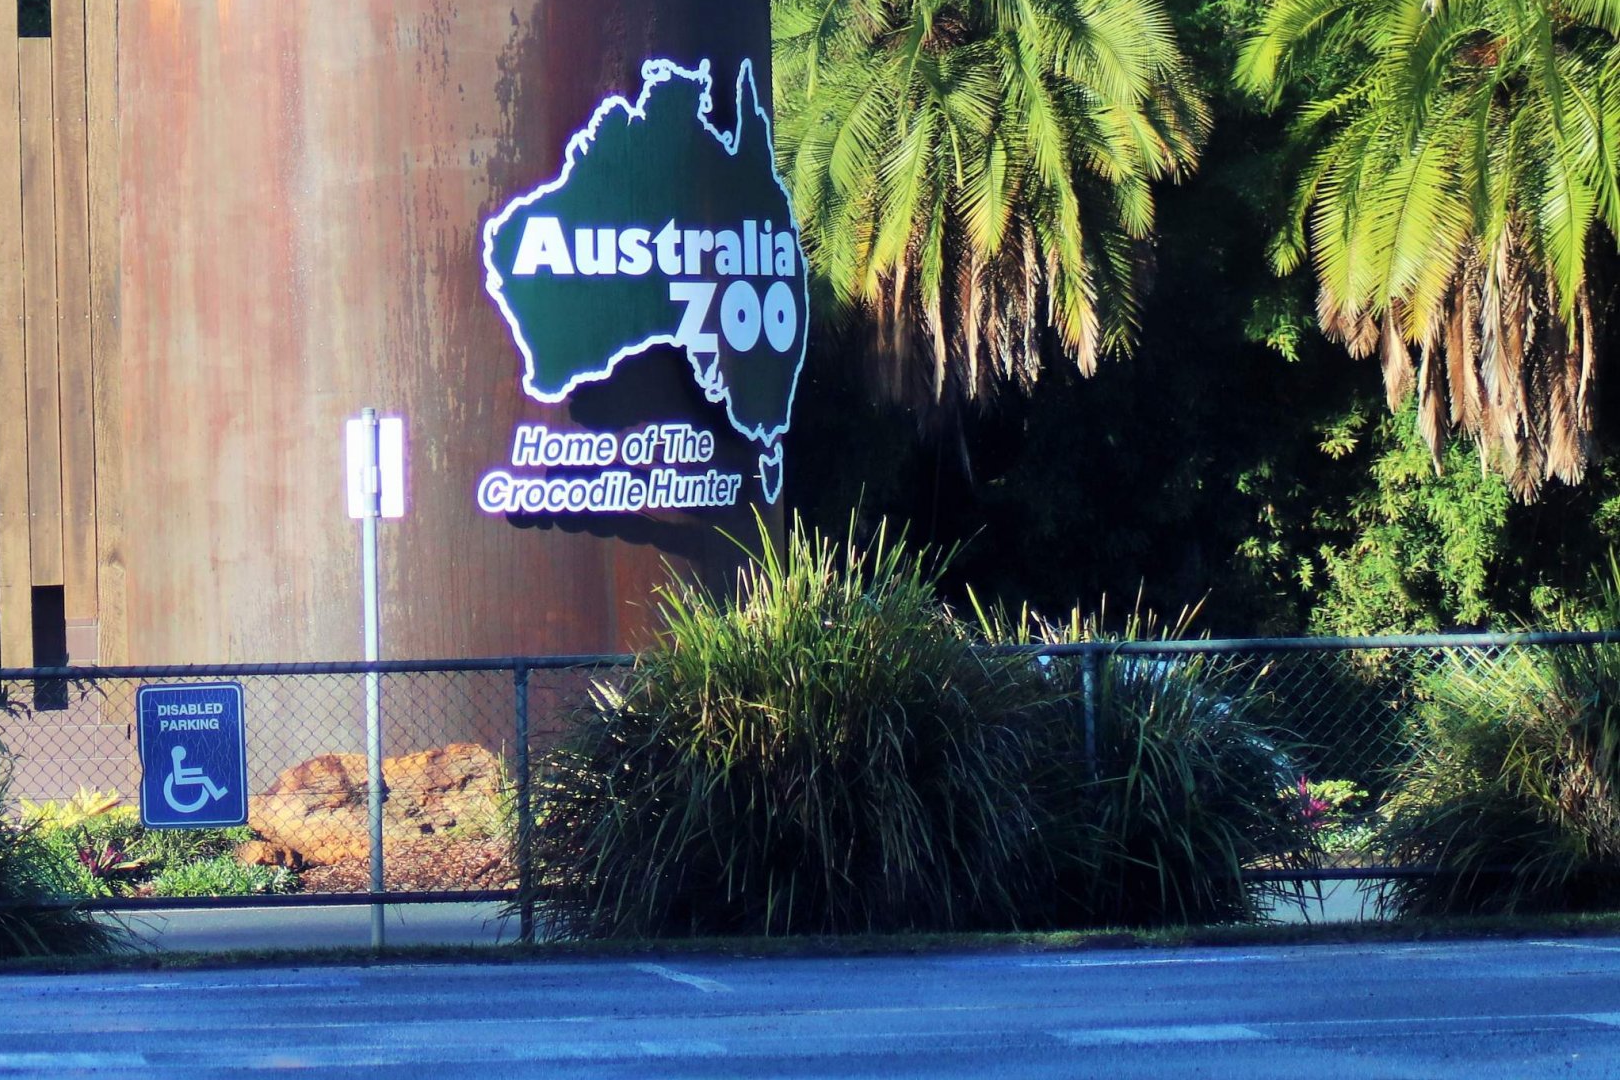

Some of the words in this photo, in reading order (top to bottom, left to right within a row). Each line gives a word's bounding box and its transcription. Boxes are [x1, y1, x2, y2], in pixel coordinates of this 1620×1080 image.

[512, 217, 796, 277] Australia
[670, 280, 797, 352] ZOO
[512, 426, 617, 466] Home
[622, 425, 661, 465] of
[660, 425, 715, 464] The
[478, 471, 645, 513] Crocodile
[646, 469, 742, 506] Hunter
[158, 704, 223, 716] DISABLED
[161, 720, 219, 731] PARKING
